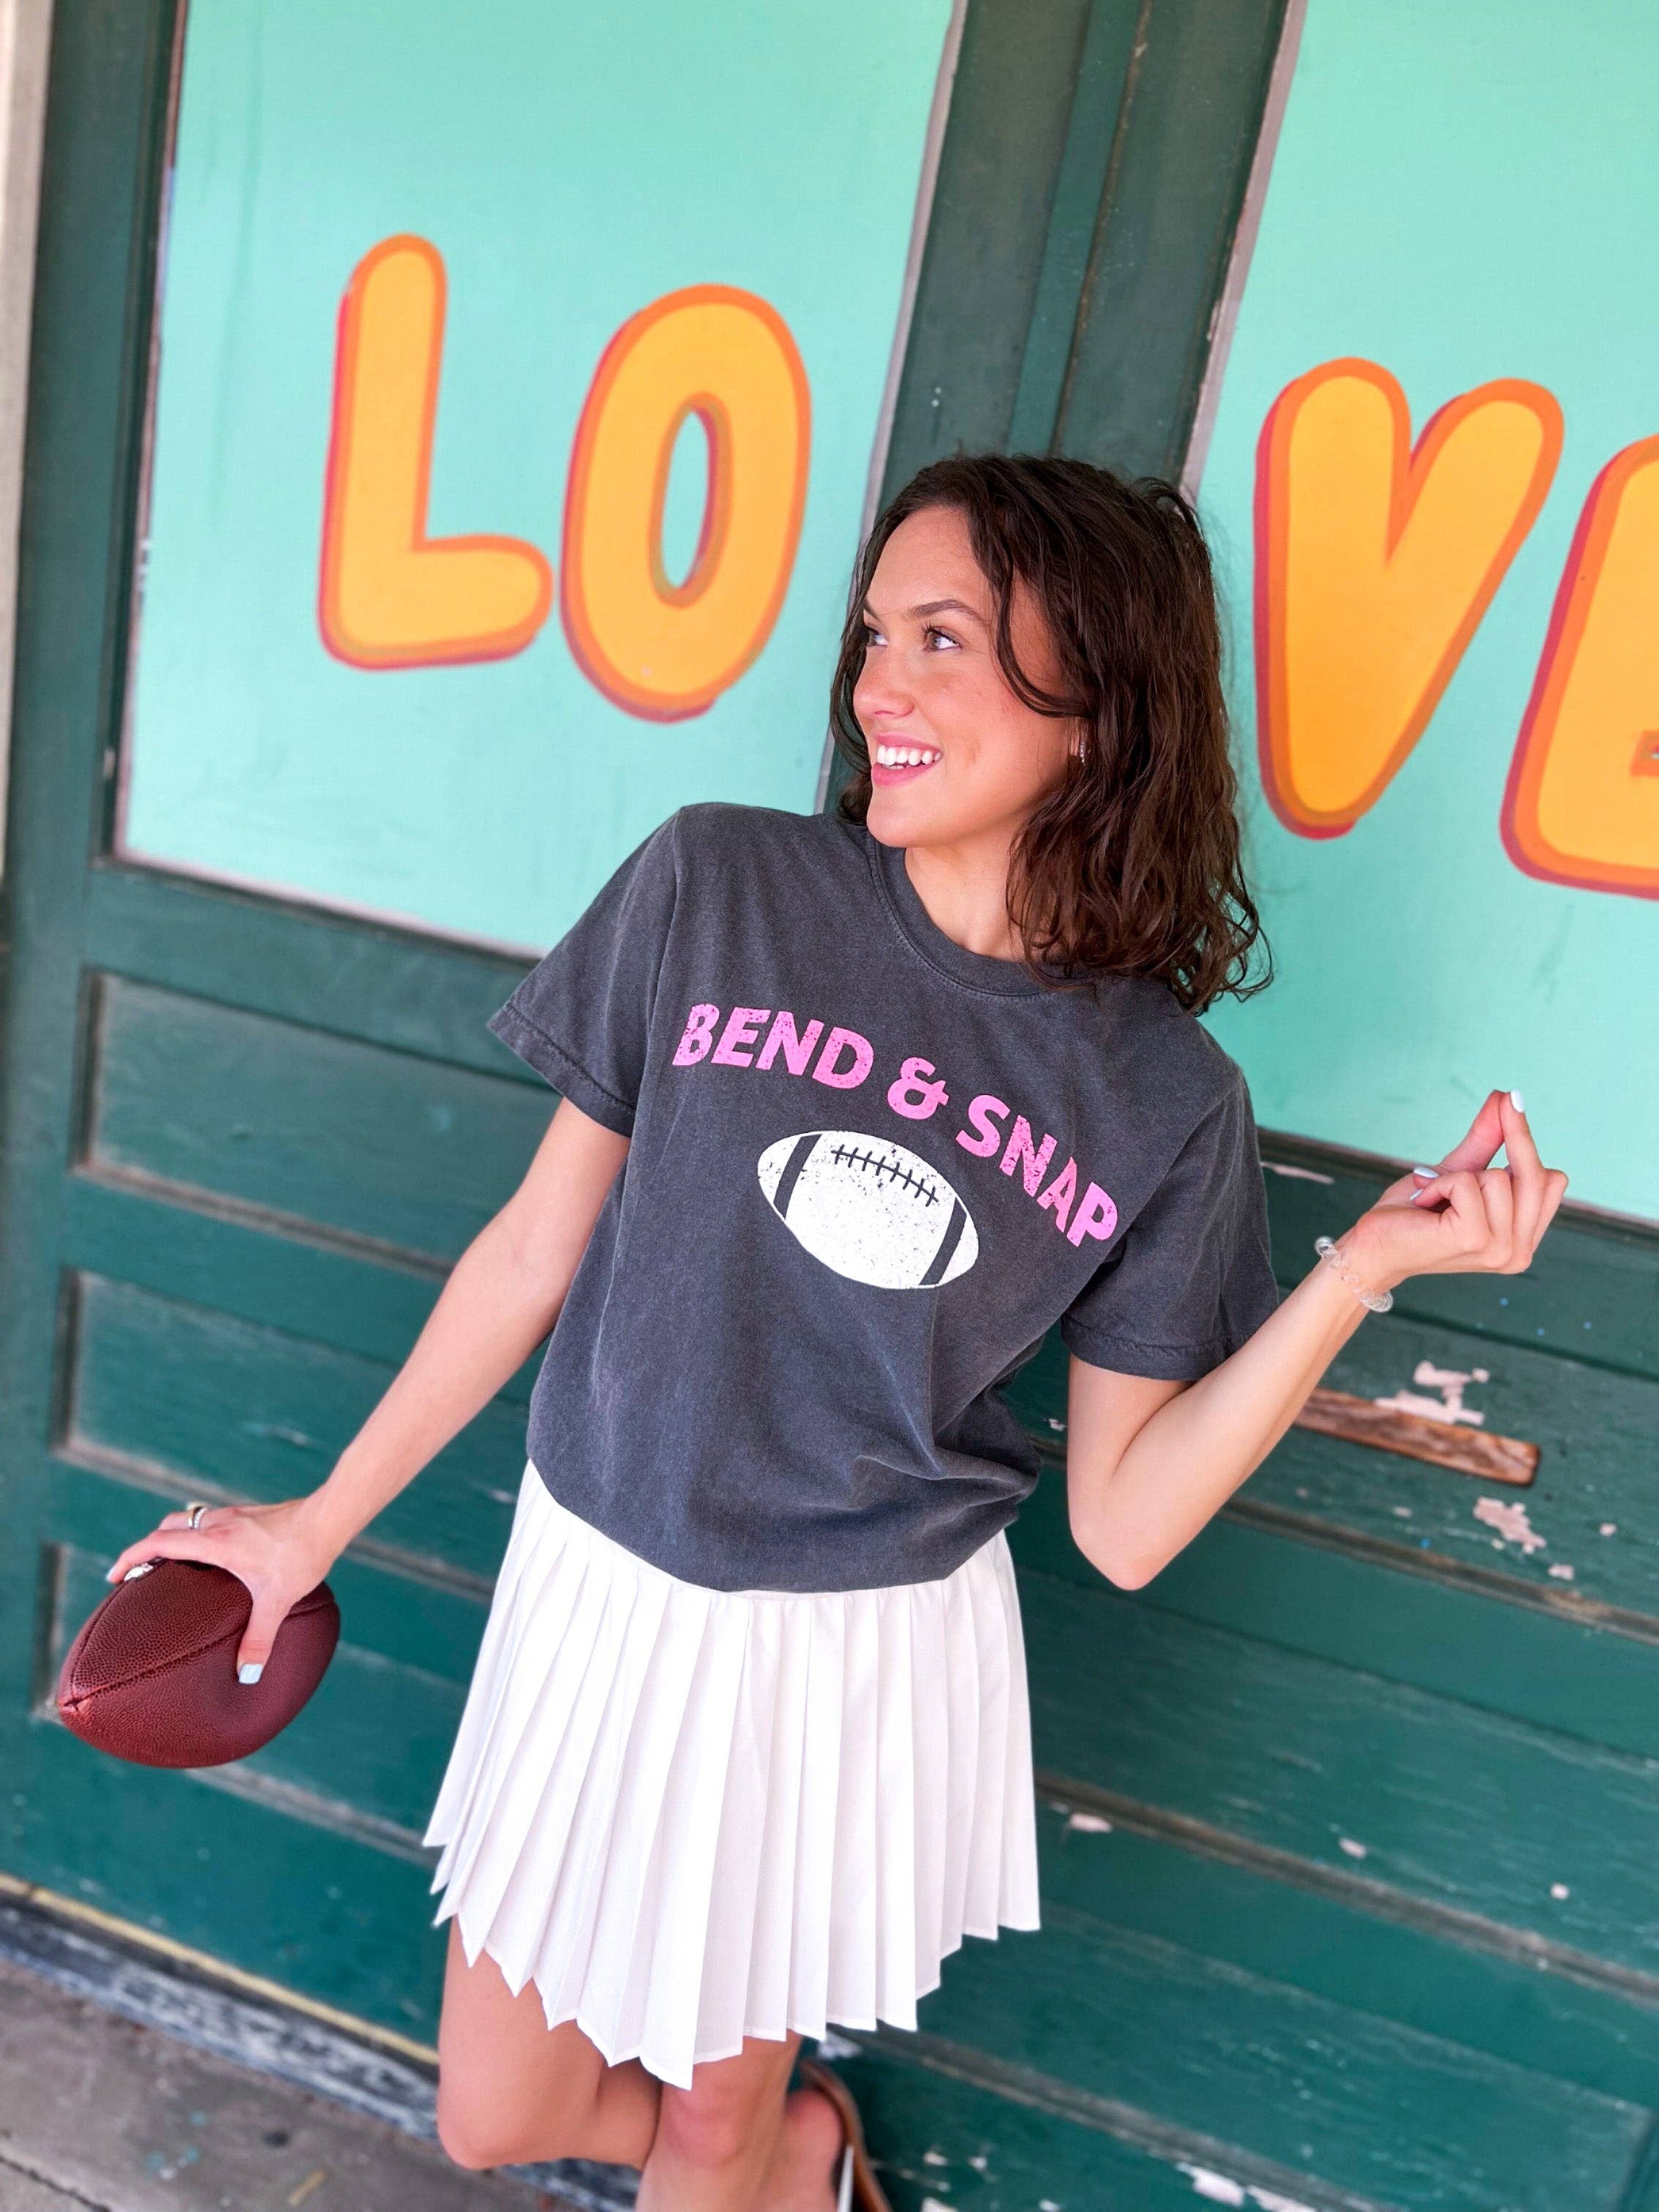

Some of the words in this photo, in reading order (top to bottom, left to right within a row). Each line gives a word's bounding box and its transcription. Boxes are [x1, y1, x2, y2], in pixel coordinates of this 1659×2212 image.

[672, 1003, 874, 1089] BEND
[887, 1057, 949, 1120] &
[956, 1094, 1118, 1247] SNAP
